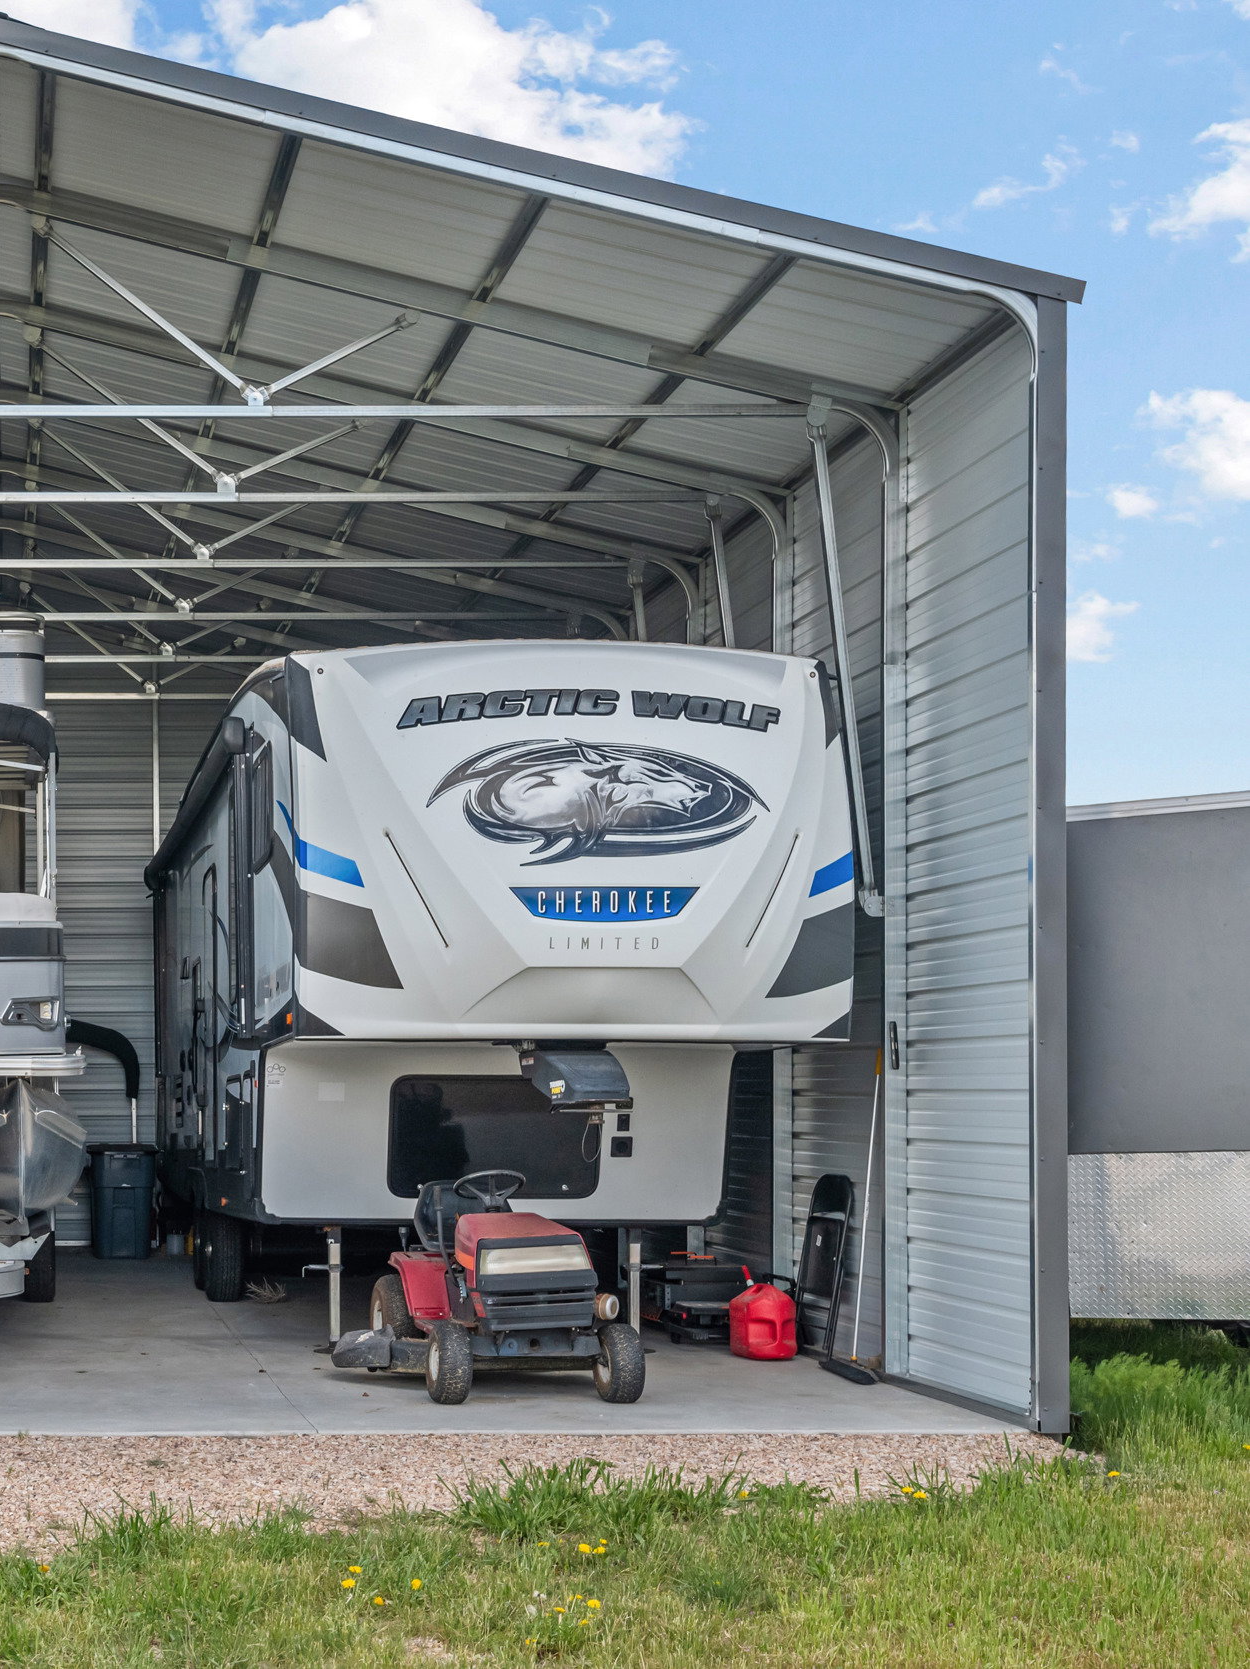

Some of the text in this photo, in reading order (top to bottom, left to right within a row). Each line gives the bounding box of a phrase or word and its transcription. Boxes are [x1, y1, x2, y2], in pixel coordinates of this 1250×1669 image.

[396, 688, 781, 732] ARCTIC WOLF
[537, 890, 671, 914] CHEROKEE
[548, 936, 660, 950] LIMITED
